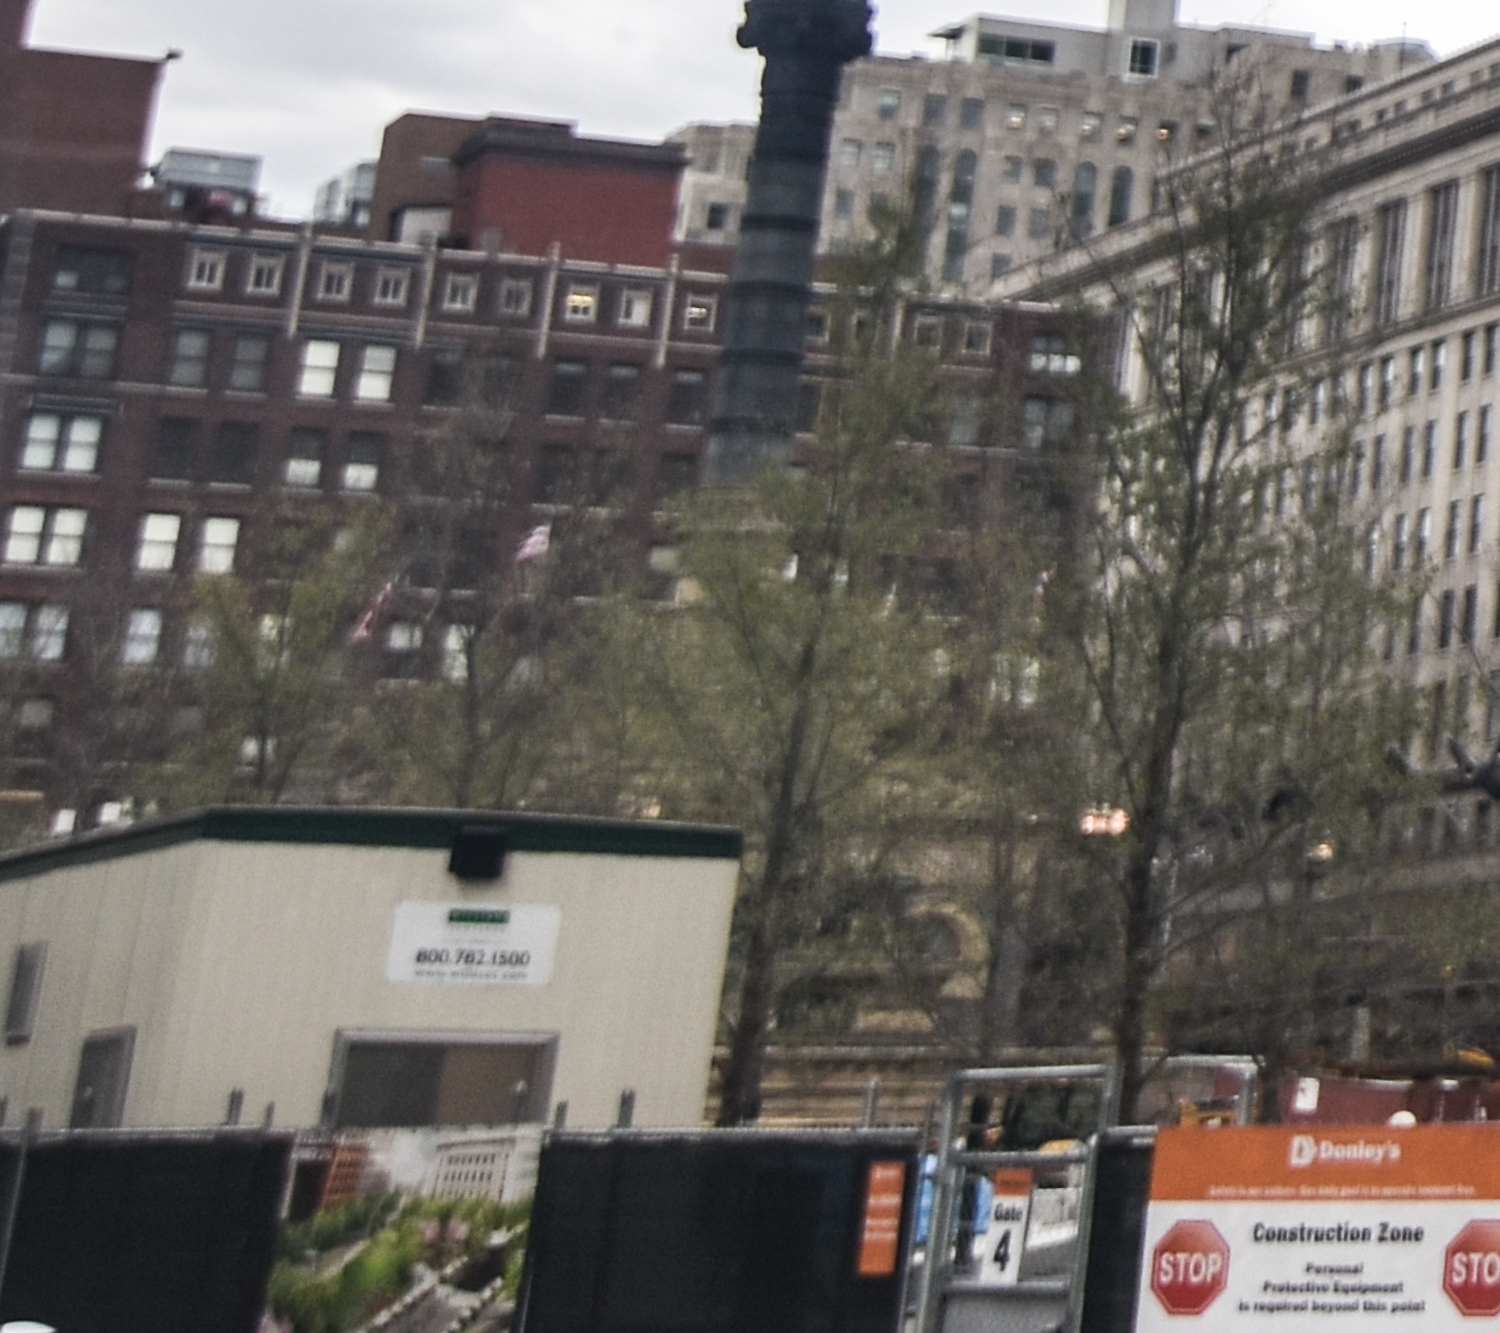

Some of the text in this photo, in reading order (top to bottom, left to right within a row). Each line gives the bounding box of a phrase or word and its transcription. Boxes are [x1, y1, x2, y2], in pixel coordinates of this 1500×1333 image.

[1319, 1140, 1401, 1165] Donley's
[994, 1202, 1023, 1222] Gate
[1253, 1221, 1425, 1243] Construction Zone
[993, 1229, 1012, 1272] 4
[1160, 1251, 1223, 1284] STOP
